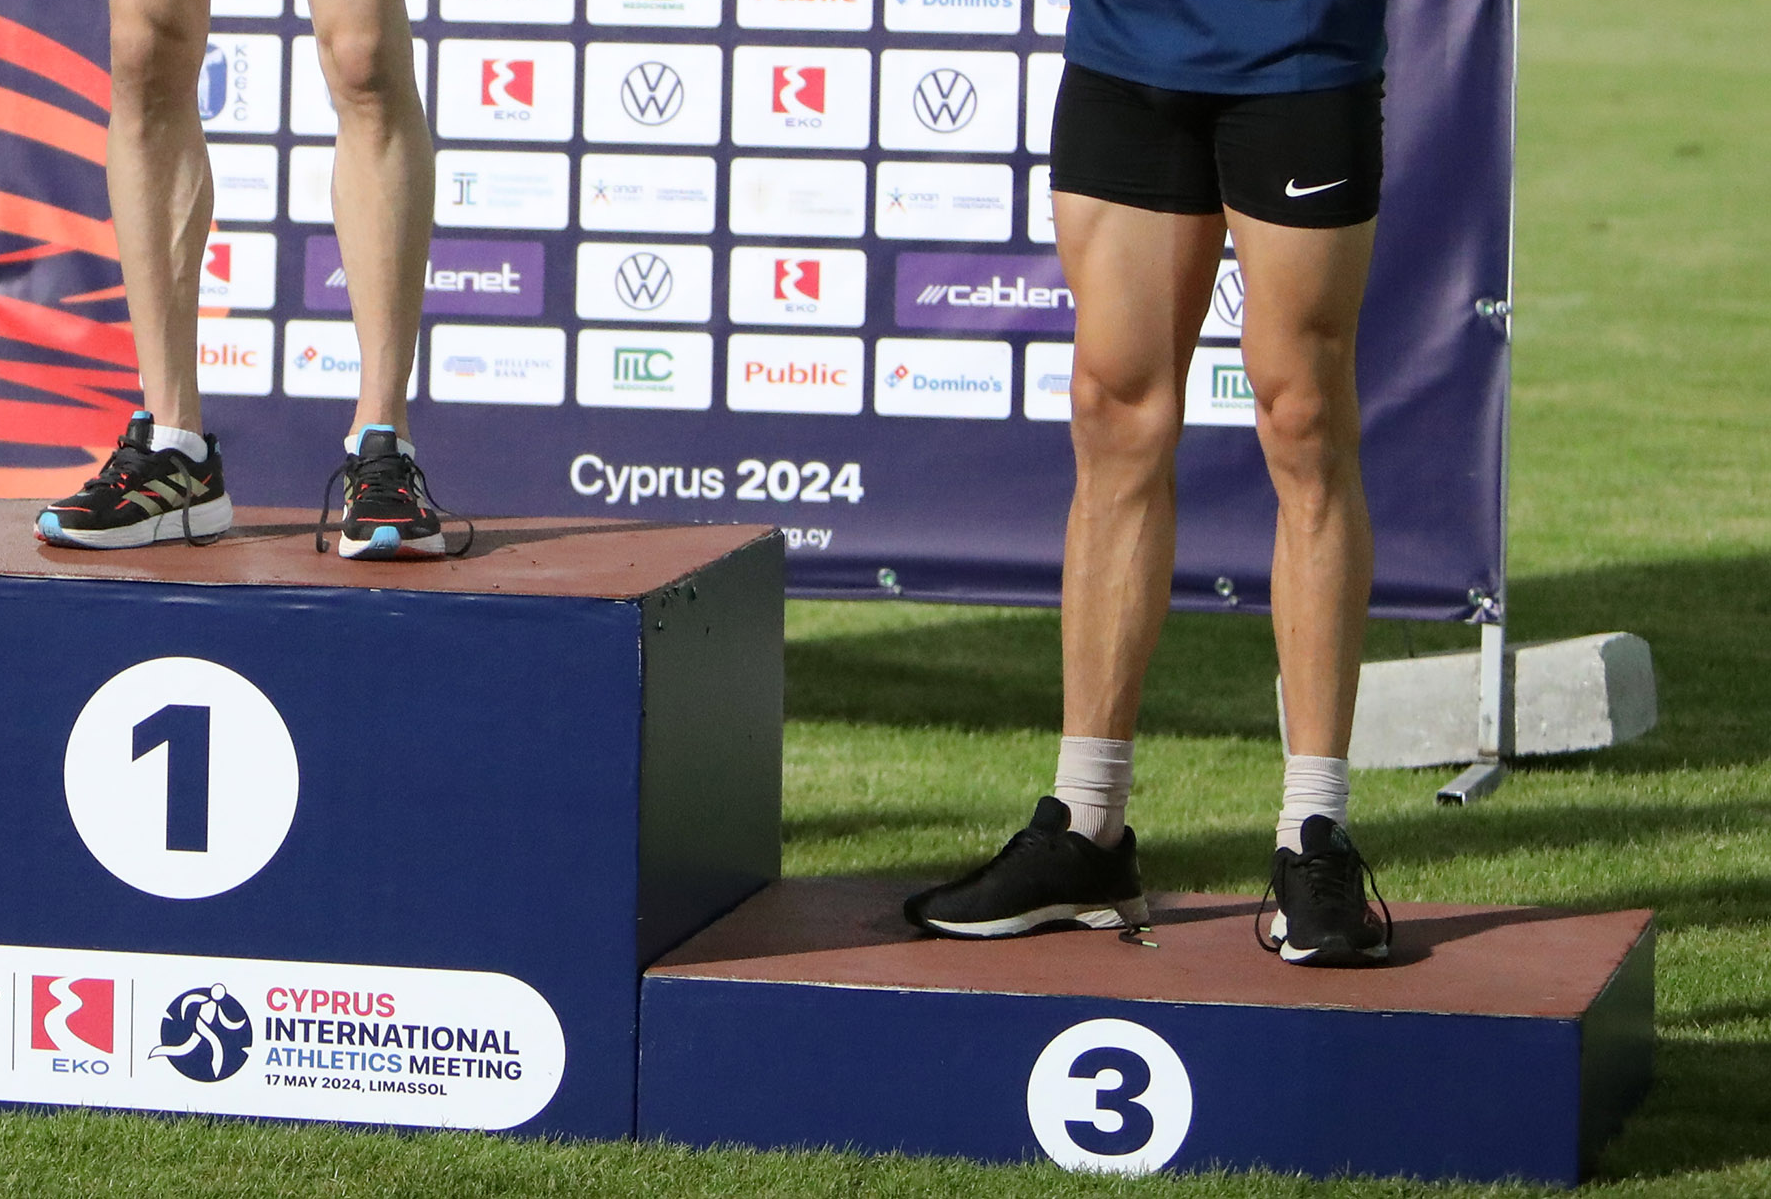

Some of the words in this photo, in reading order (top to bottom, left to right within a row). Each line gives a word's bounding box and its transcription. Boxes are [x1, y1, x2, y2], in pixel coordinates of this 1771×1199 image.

[493, 109, 531, 120] EKO
[785, 117, 823, 129] EKO
[424, 260, 521, 294] lenet
[947, 275, 1076, 309] cablen
[784, 303, 818, 313] EKO
[199, 343, 258, 368] blic
[744, 361, 849, 387] Public
[912, 374, 1003, 393] Domino's
[570, 454, 726, 505] Cyprus
[735, 459, 865, 504] 2024
[130, 703, 212, 853] 1
[266, 987, 396, 1018] CYPRUS
[265, 1016, 521, 1056] INTERNATIONAL
[51, 1057, 110, 1075] EKO
[265, 1047, 404, 1074] ATHLETICS
[408, 1055, 524, 1082] MEETING
[264, 1074, 281, 1086] 17
[284, 1075, 319, 1089] MAY
[322, 1077, 366, 1094] 2024,
[369, 1079, 448, 1097] LIMASSOL
[1064, 1046, 1155, 1156] 3
